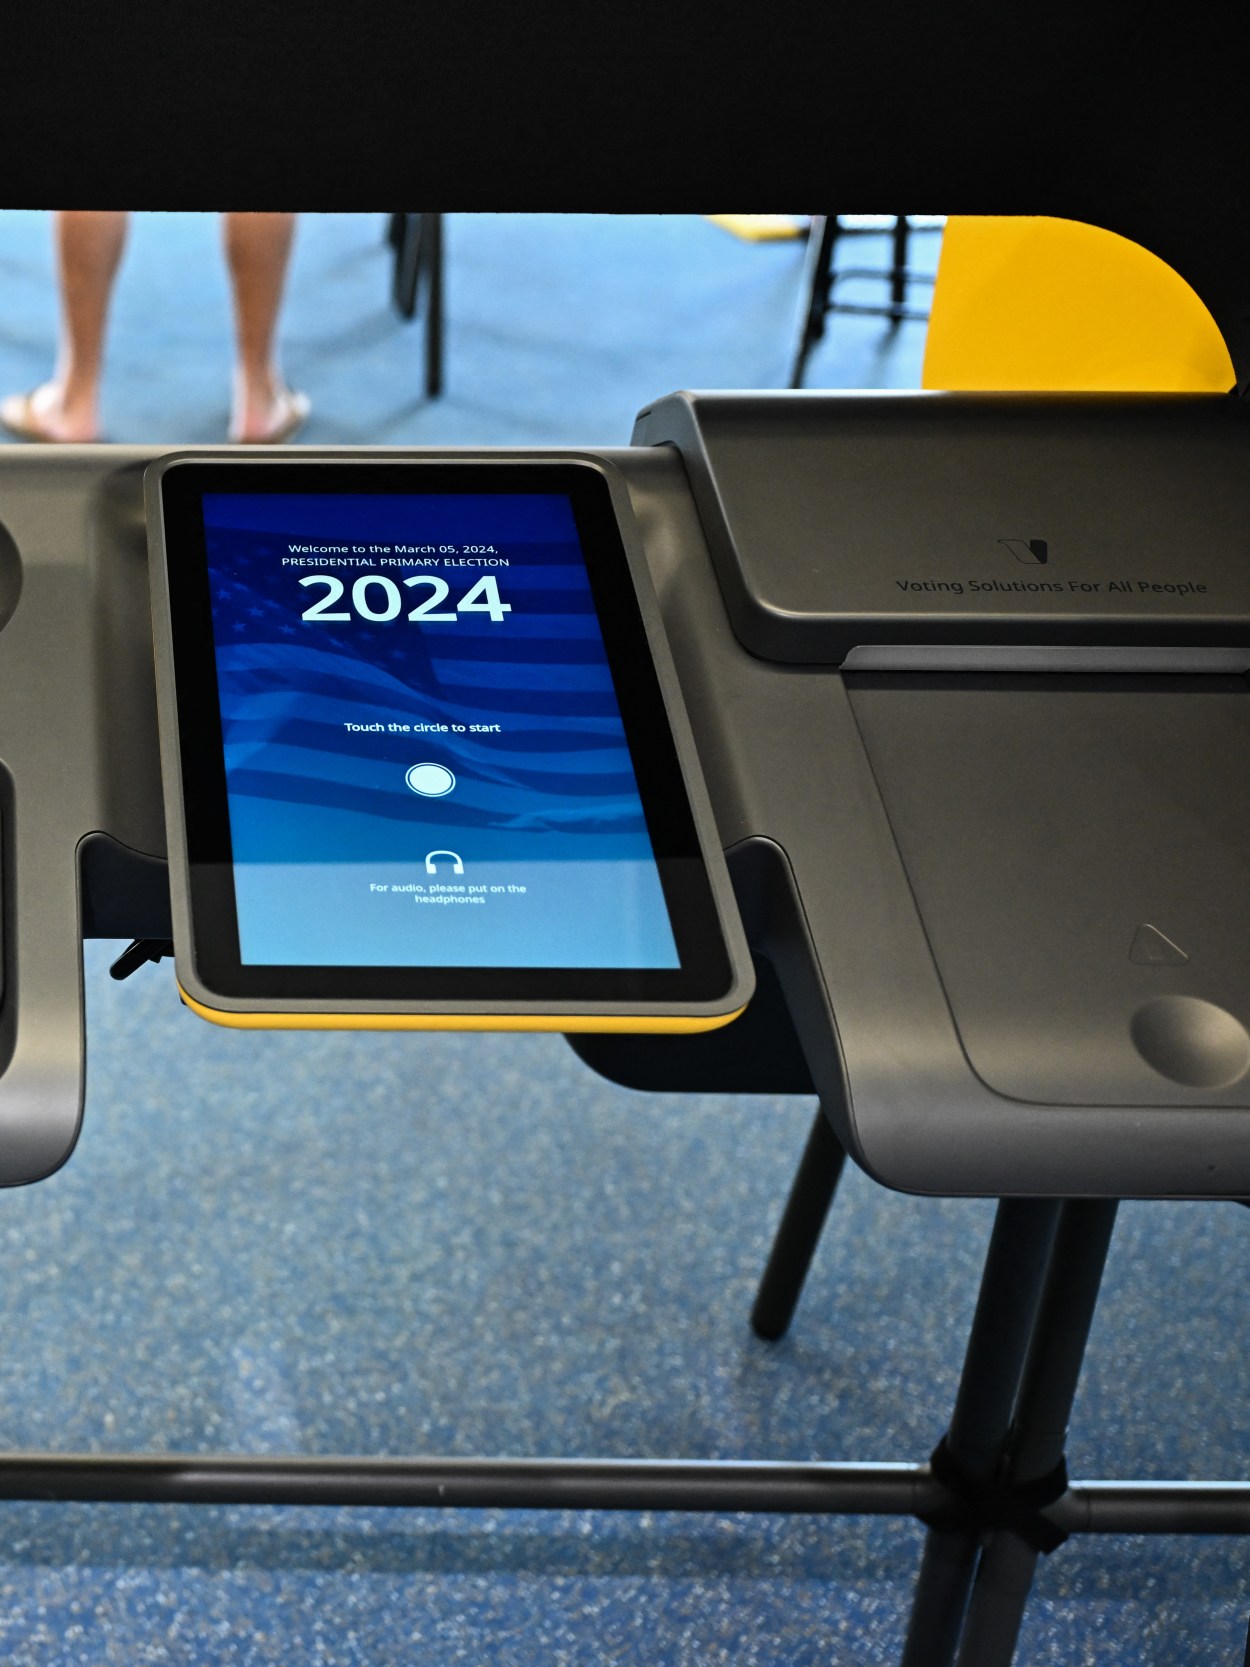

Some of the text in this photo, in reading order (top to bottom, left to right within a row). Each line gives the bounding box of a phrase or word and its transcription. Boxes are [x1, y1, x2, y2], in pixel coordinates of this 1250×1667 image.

[288, 544, 499, 555] Welcome to the March 05, 2024,
[281, 557, 510, 567] PRESIDENTIAL PRIMARY ELECTION
[895, 580, 1208, 596] Voting Solutions For All People
[298, 575, 512, 622] 2024
[344, 722, 501, 733] Touch the circle to start
[370, 883, 527, 896] For audio, please put on the
[414, 894, 486, 905] headphones
